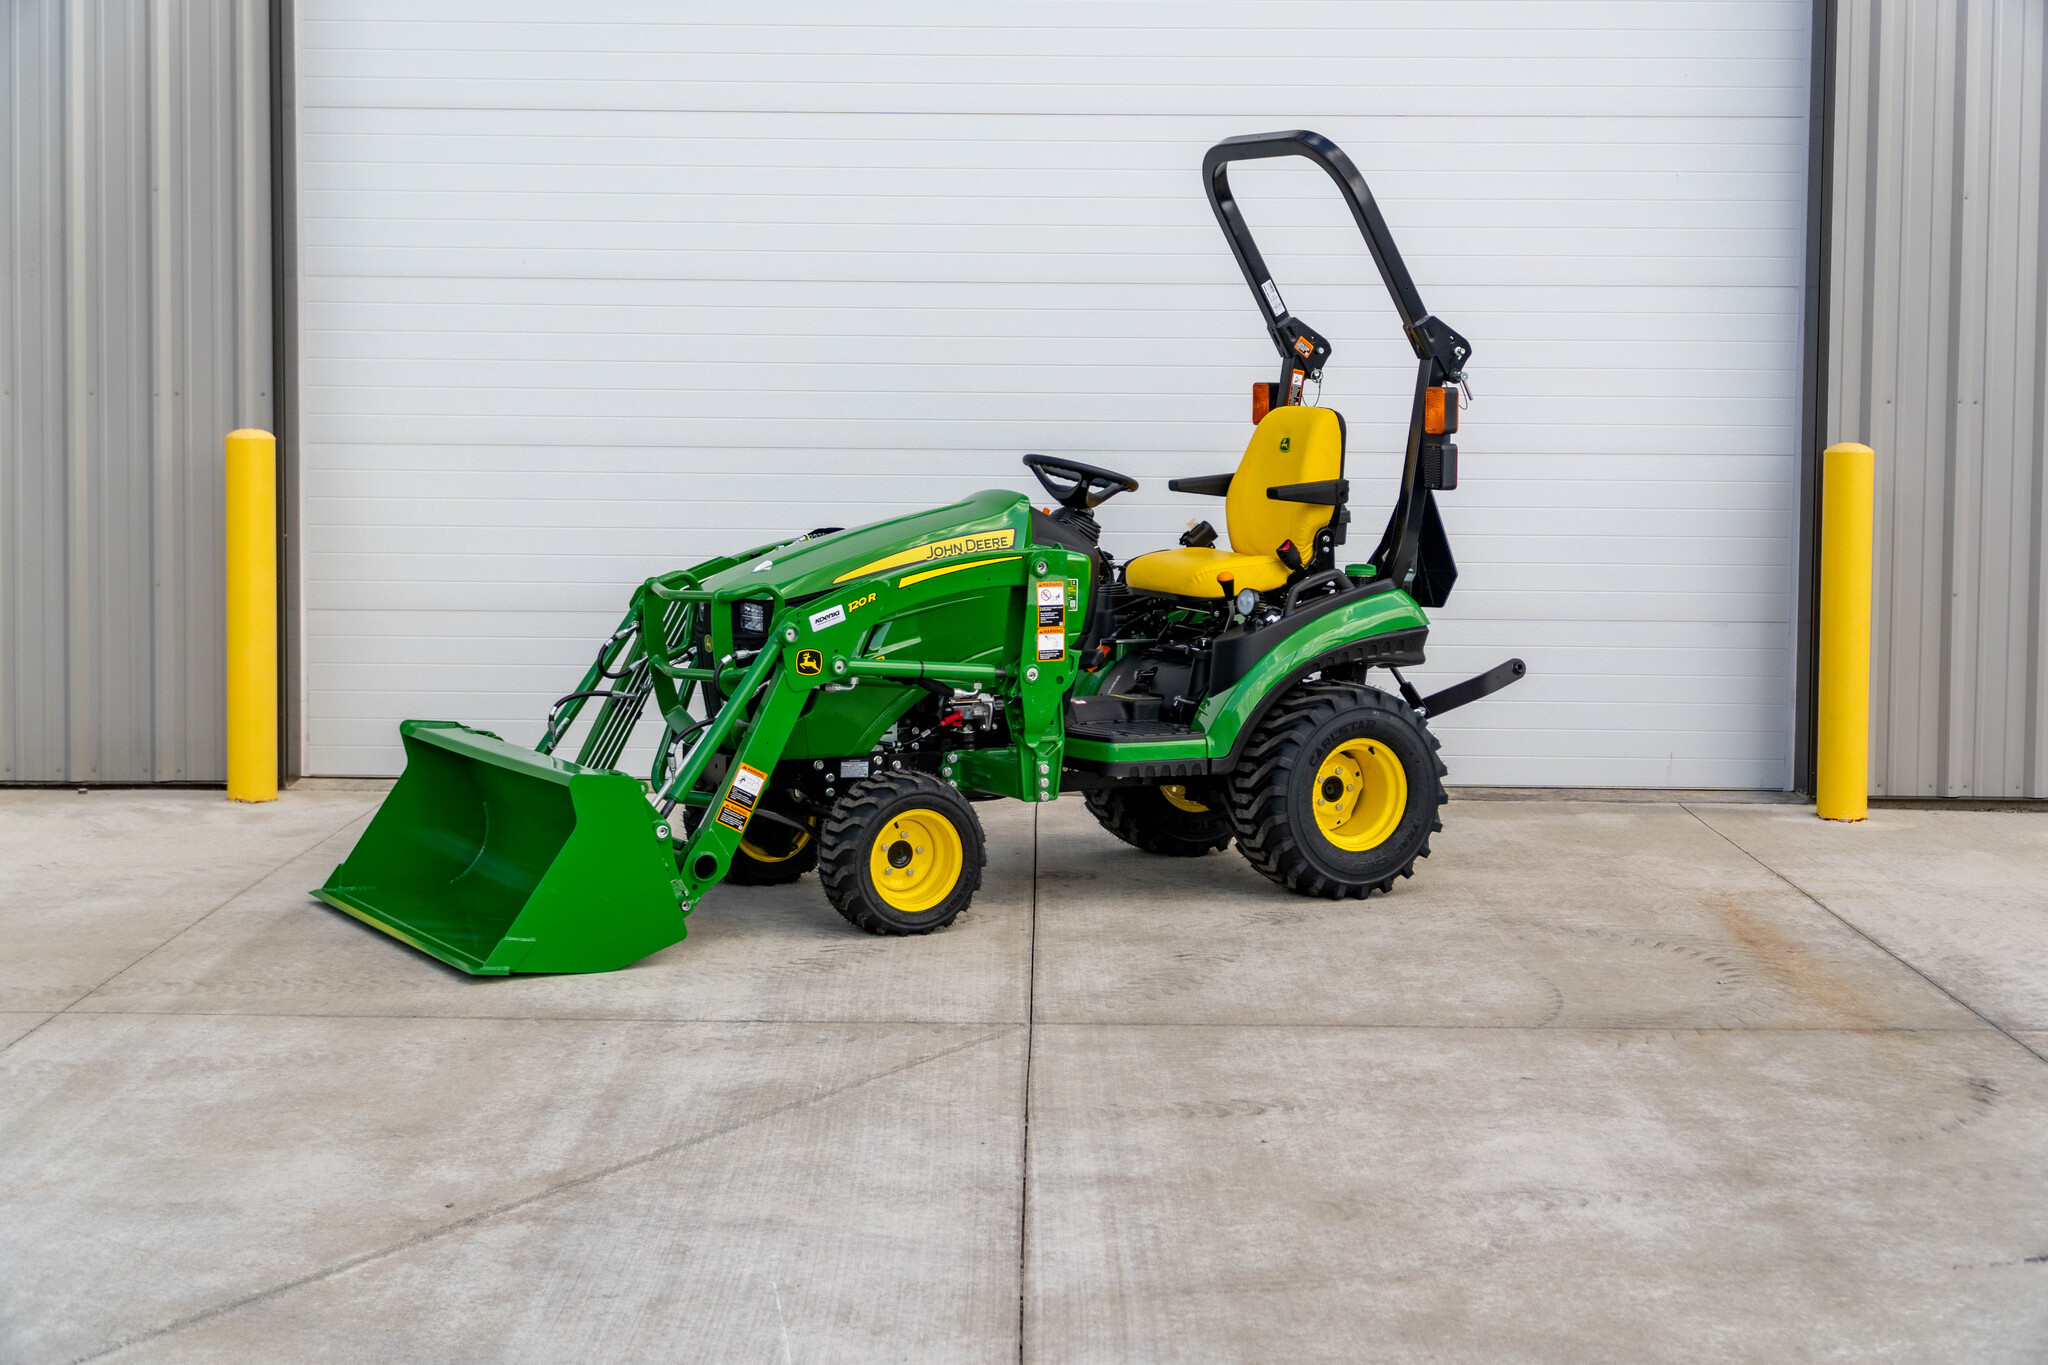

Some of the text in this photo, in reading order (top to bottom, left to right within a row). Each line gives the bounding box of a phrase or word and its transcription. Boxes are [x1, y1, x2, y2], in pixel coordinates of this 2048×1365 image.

[926, 536, 1009, 560] JOHN DEERE
[1308, 719, 1377, 768] CARLSTAR
